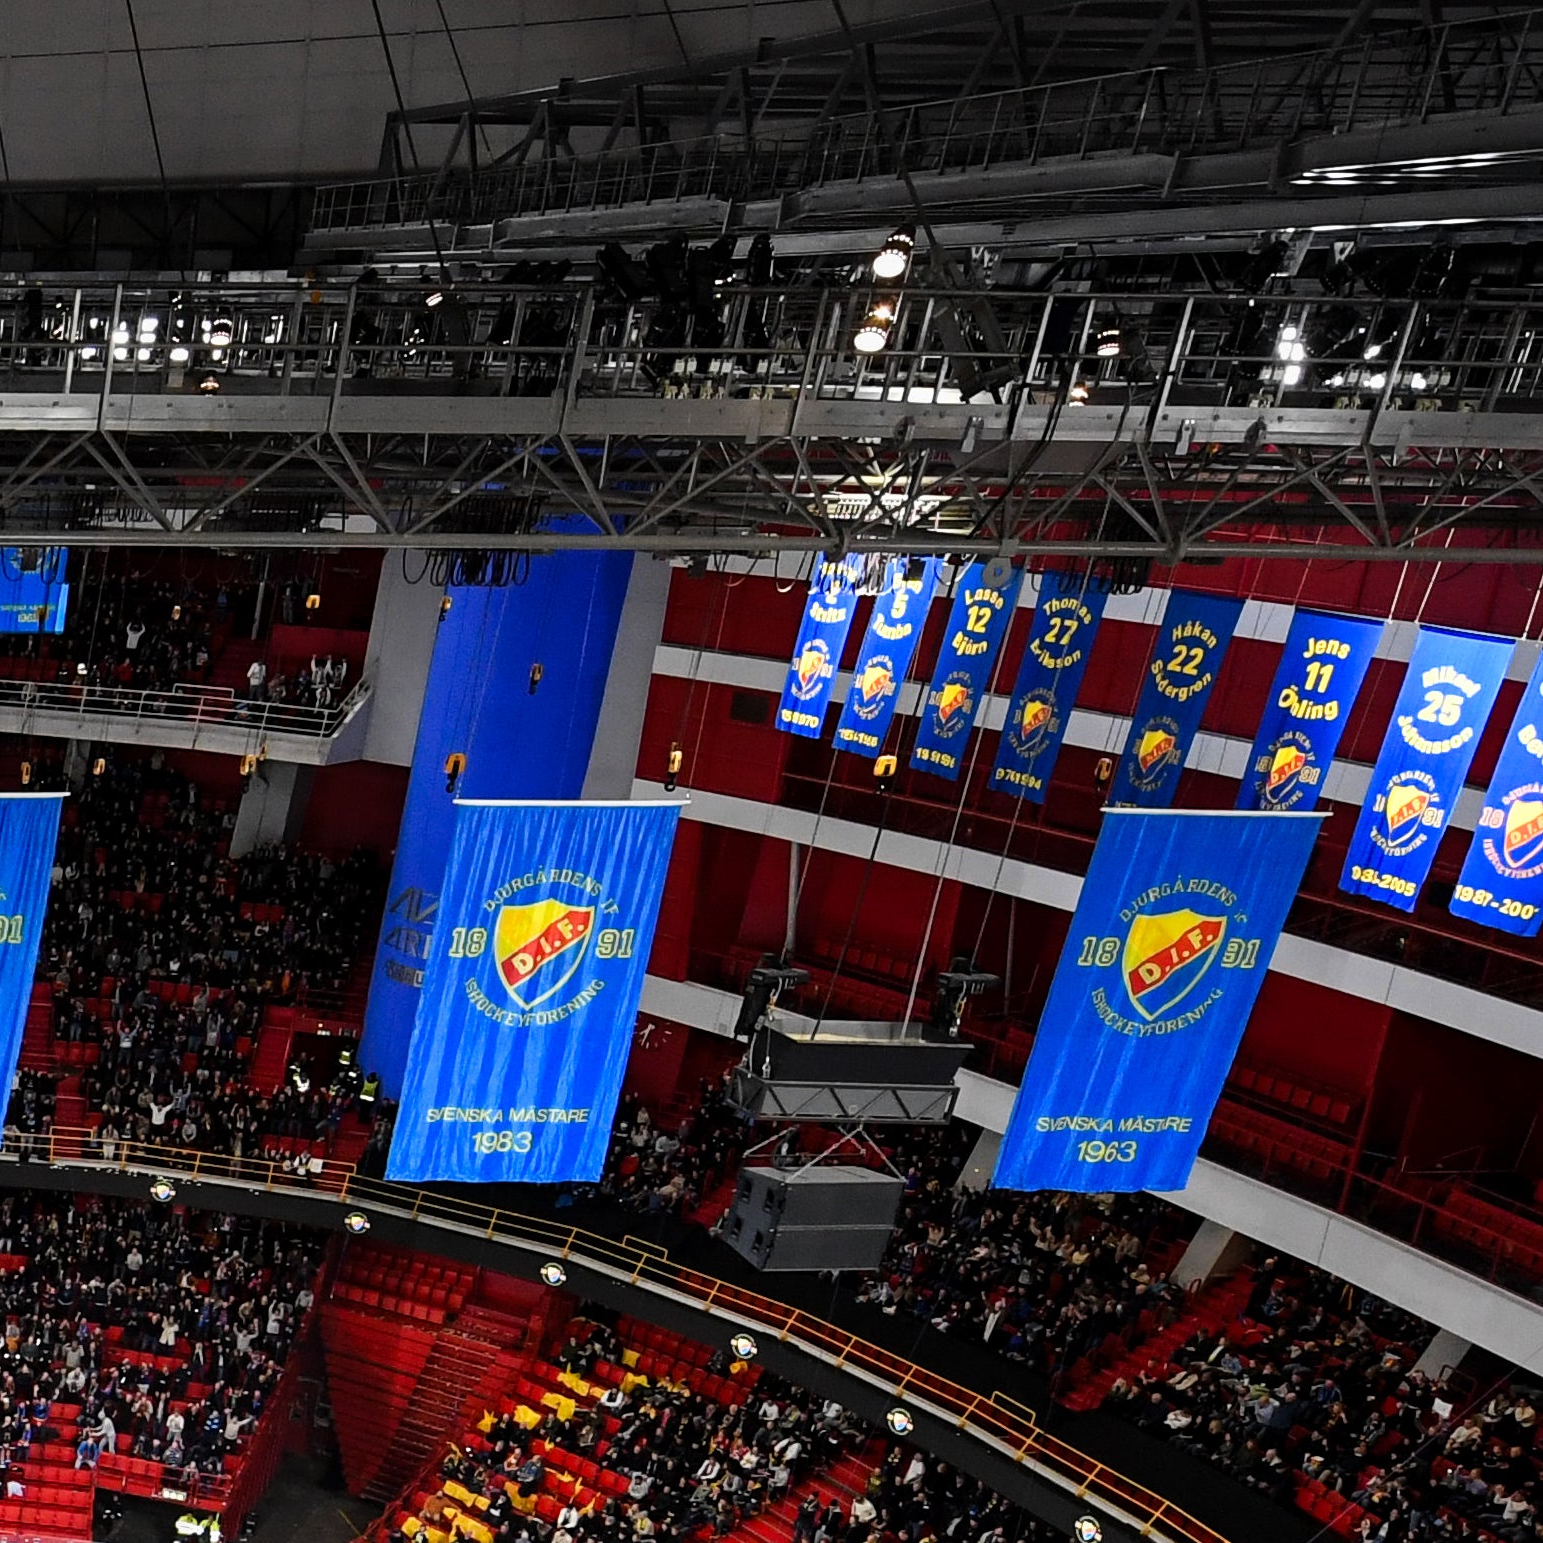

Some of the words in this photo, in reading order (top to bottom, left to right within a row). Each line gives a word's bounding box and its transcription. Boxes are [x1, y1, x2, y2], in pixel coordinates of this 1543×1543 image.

[966, 606, 992, 633] 12
[1044, 617, 1079, 646] 27
[1171, 620, 1217, 649] Håkan
[1303, 637, 1351, 659] Jens
[1167, 644, 1205, 675] 22
[1304, 662, 1333, 693] 11
[1417, 690, 1464, 726] 25
[448, 927, 487, 957] 18
[595, 928, 635, 958] 91
[1077, 937, 1118, 967] 18
[426, 1106, 503, 1123] SVENSKA
[1036, 1116, 1114, 1133] SVENSKA
[471, 1131, 533, 1153] 1983
[1077, 1141, 1137, 1163] 1963
